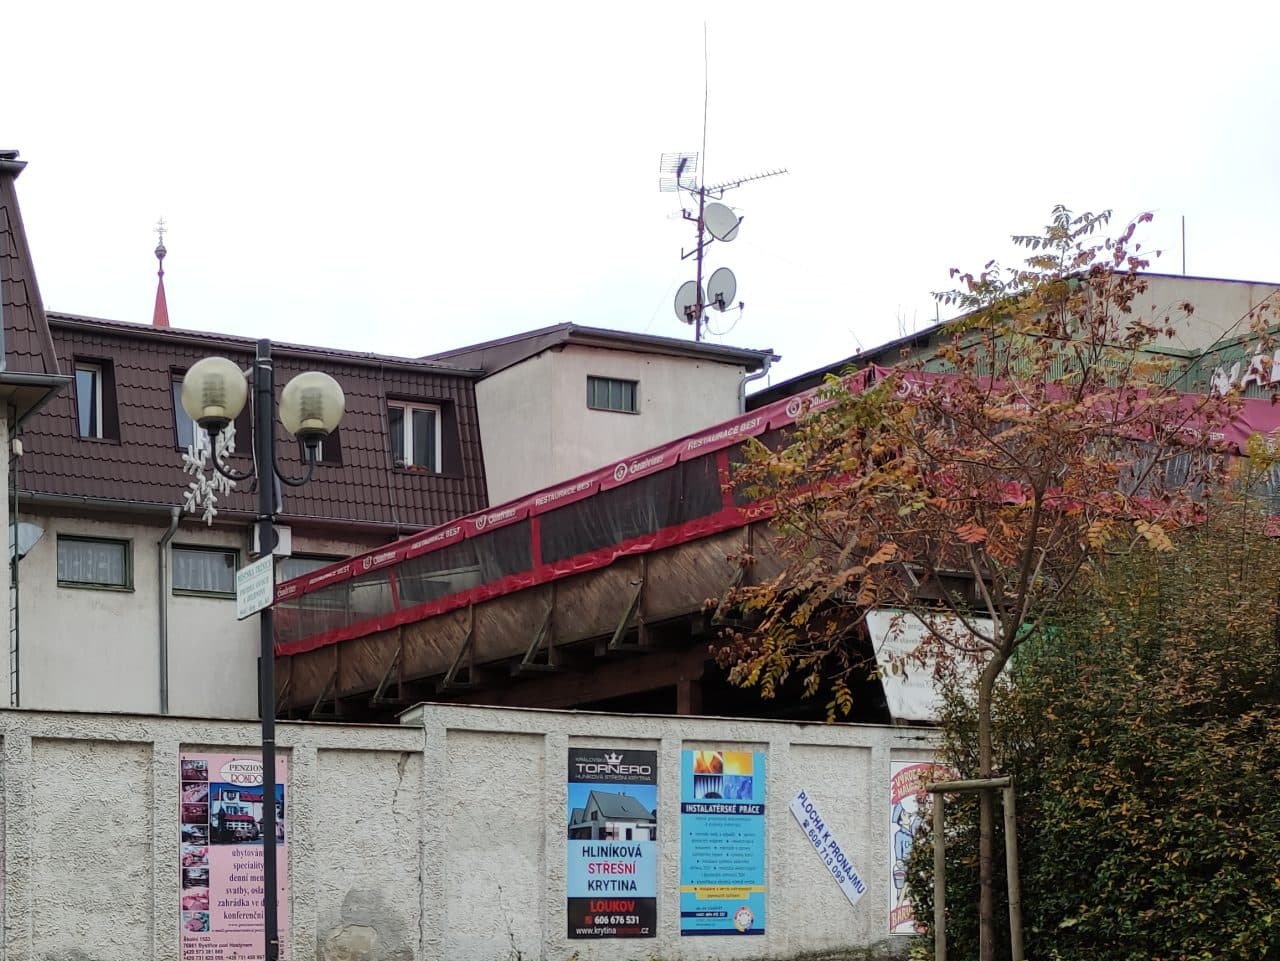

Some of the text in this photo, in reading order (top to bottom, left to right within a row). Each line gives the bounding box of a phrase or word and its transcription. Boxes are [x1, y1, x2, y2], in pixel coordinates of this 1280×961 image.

[688, 417, 763, 450] RESTAURACE BEST
[576, 763, 652, 775] TORNERO
[739, 803, 761, 814] PRÁCE
[798, 791, 866, 894] PLOCHA K PRONÁJMU
[231, 848, 264, 859] ubytován
[582, 844, 642, 858] HLINÍKOVÁ
[808, 829, 846, 884] 608 713 099
[588, 860, 636, 874] STŘEŠNÍ
[587, 879, 637, 892] KRYTINA
[590, 900, 635, 912] LOUKOV
[594, 916, 639, 924] 606 676 531
